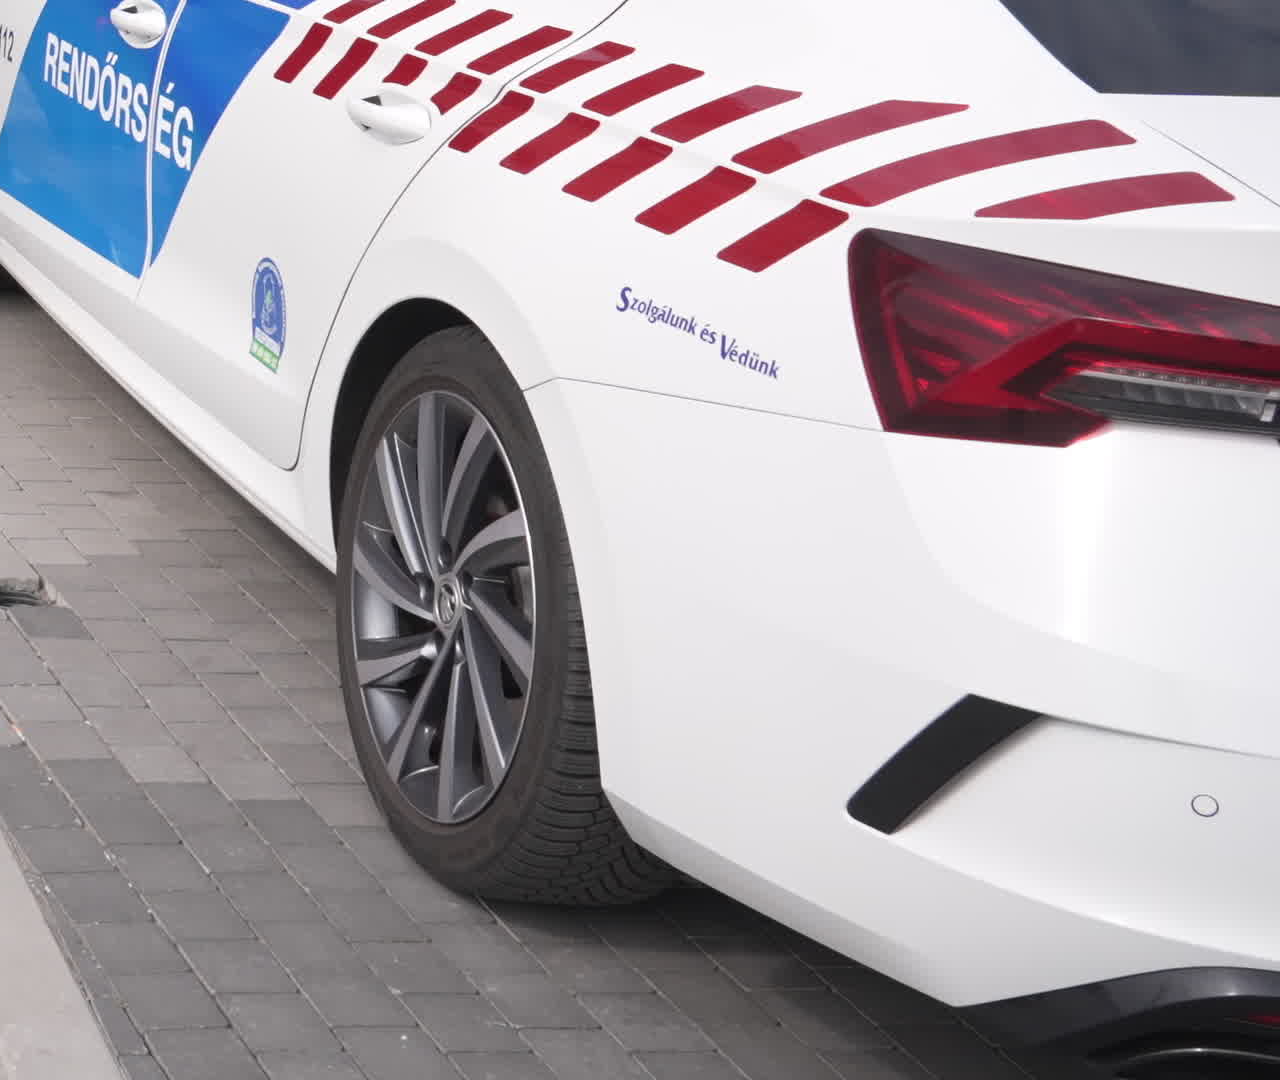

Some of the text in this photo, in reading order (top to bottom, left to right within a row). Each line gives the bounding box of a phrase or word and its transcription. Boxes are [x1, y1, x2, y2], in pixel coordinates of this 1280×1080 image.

[43, 31, 194, 171] RENDŐRSÉG
[615, 286, 779, 379] Szolgálunk és Védünk
